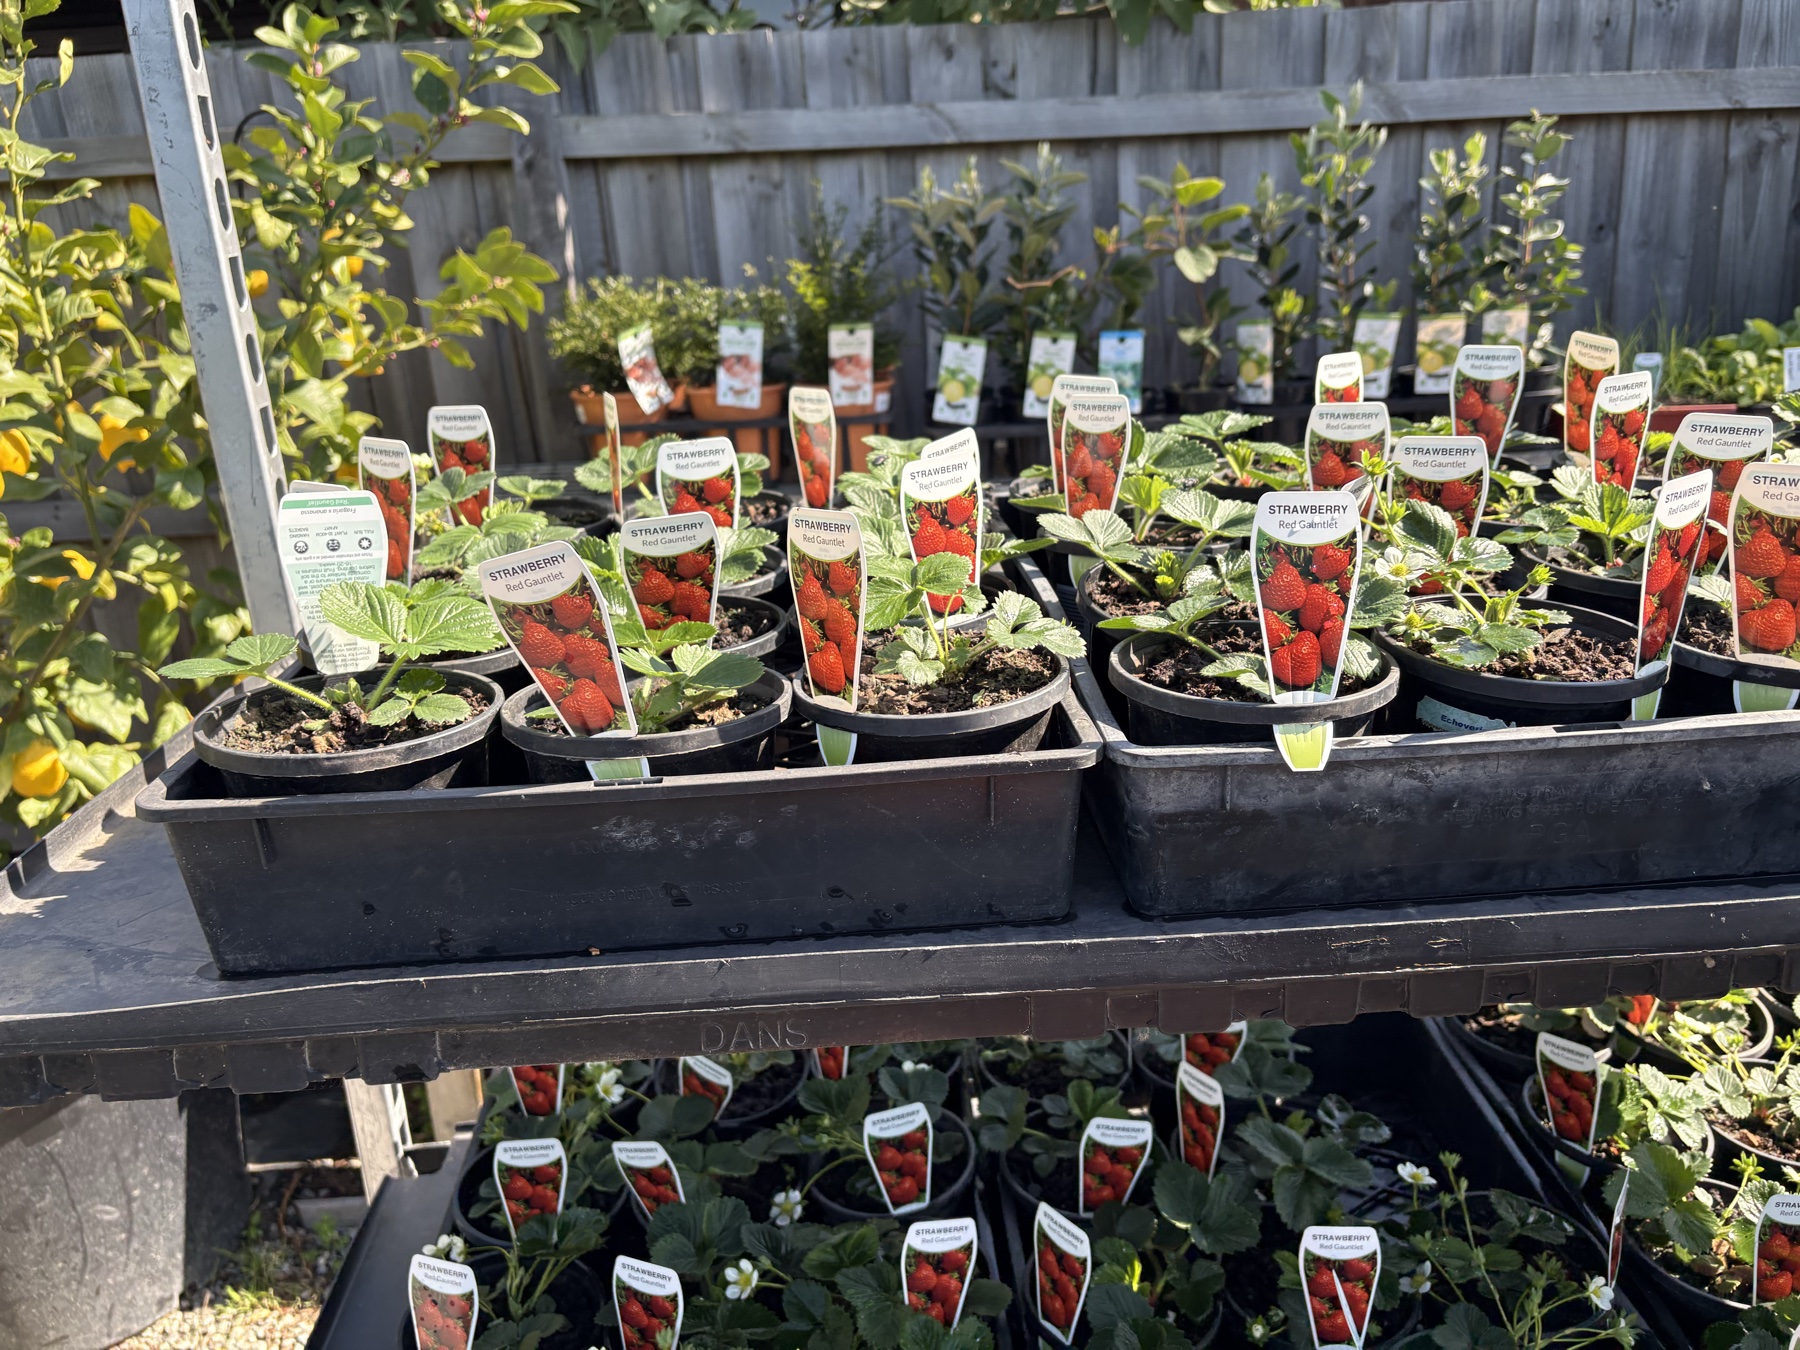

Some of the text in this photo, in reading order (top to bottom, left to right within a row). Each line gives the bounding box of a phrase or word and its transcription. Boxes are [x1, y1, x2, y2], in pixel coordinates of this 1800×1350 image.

[1574, 340, 1613, 354] STRAWBERRY
[1465, 354, 1516, 362] STRAWBERRY
[1060, 384, 1110, 394] STRAWBERRY
[1604, 381, 1648, 394] STRAWBERRY
[1608, 393, 1641, 403] Red Gauntlet
[1073, 404, 1122, 412] STRAWBERRY
[436, 414, 482, 423] STRAWBERRY
[1078, 414, 1115, 423] Red Gauntlet
[1318, 412, 1380, 420] STRAWBERRY
[1326, 422, 1372, 430] Red Gauntlet
[1690, 424, 1765, 437] STRAWBERRY
[1696, 436, 1752, 449] Red Gauntlet
[364, 446, 404, 460] STRAWBERRY
[666, 448, 726, 461] STRAWBERRY
[1404, 447, 1476, 456] STRAWBERRY
[370, 458, 400, 470] Red Gauntlet
[676, 460, 720, 470] Red Gauntlet
[1412, 460, 1466, 468] Red Gauntlet
[910, 461, 968, 481] STRAWBERRY
[918, 476, 964, 491] Red Gauntlet
[1752, 475, 1800, 488] STRAW
[1664, 482, 1708, 504] STRAWBERRY
[1762, 490, 1782, 500] Red
[1268, 504, 1348, 514] STRAWBERRY
[1668, 499, 1700, 516] Red Gauntlet
[630, 521, 704, 538] STRAWBERRY
[794, 518, 851, 534] STRAWBERRY
[1278, 519, 1338, 529] Red Gauntlet
[642, 534, 697, 548] Red Gauntlet
[803, 534, 845, 548] Red Gauntlet
[489, 554, 567, 582] STRAWBERRY
[505, 570, 564, 593] Red Gauntlet
[701, 1018, 808, 1052] DANS
[872, 1109, 920, 1126] STRAWBERRY
[1096, 1124, 1145, 1133] STRAWBERRY
[503, 1144, 556, 1153] STRAWBERRY
[916, 1224, 968, 1236] STRAWBERRY
[1043, 1210, 1084, 1244] STRAWBERRY
[933, 1234, 961, 1242] Gauntlet
[1312, 1234, 1370, 1242] STRAWBERRY
[418, 1262, 468, 1280] STRAWBERRY
[622, 1262, 672, 1282] STRAWBERRY
[424, 1272, 462, 1287] Red Gauntlet
[628, 1272, 666, 1290] Red Gauntlet
